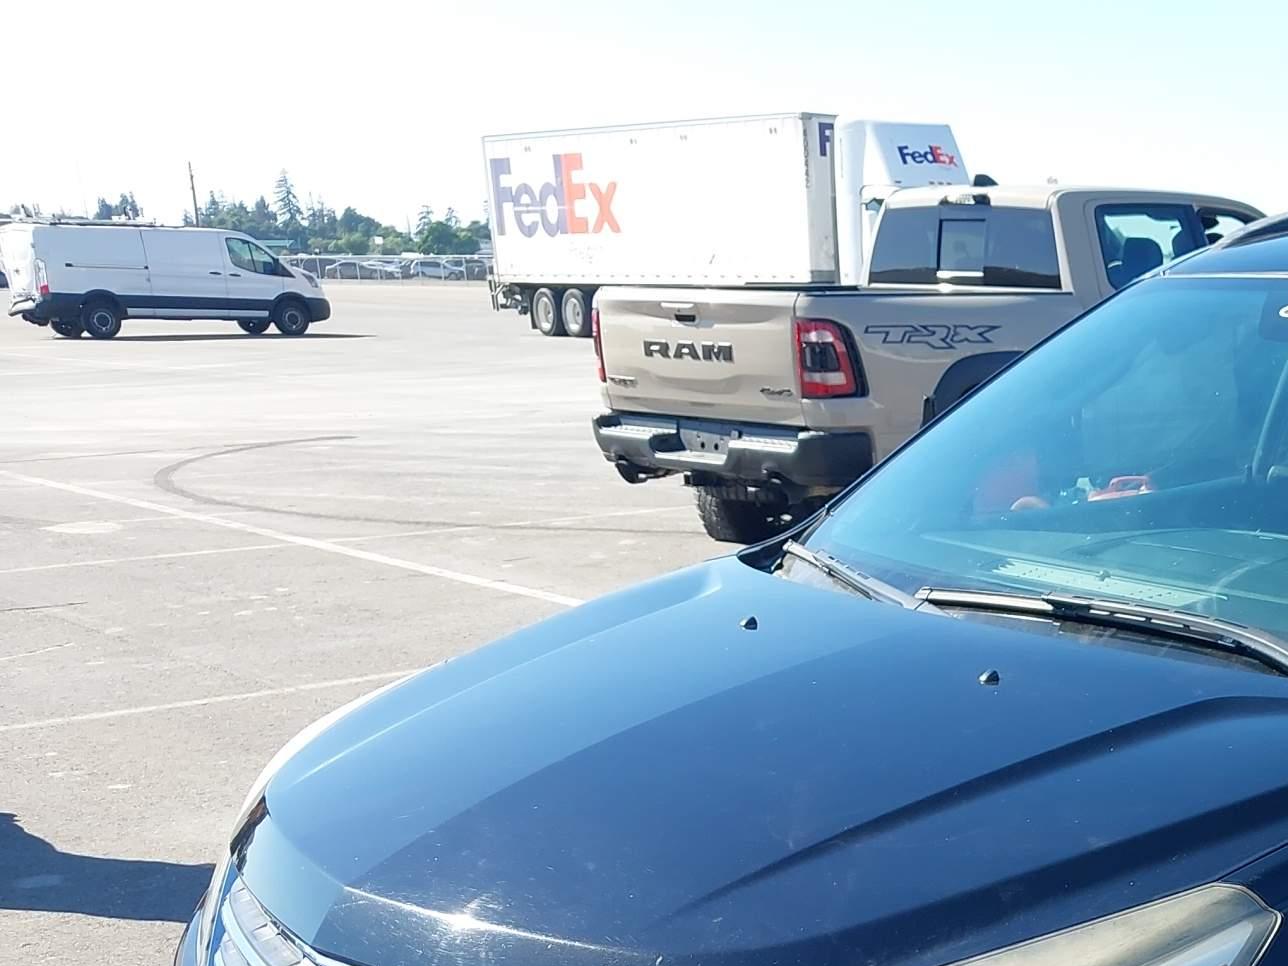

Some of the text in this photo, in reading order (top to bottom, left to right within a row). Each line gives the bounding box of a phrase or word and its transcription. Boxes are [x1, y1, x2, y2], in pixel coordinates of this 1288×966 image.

[897, 144, 958, 168] FedEx
[489, 152, 622, 238] FedEx
[864, 324, 1002, 350] TRX
[643, 338, 735, 363] RAM
